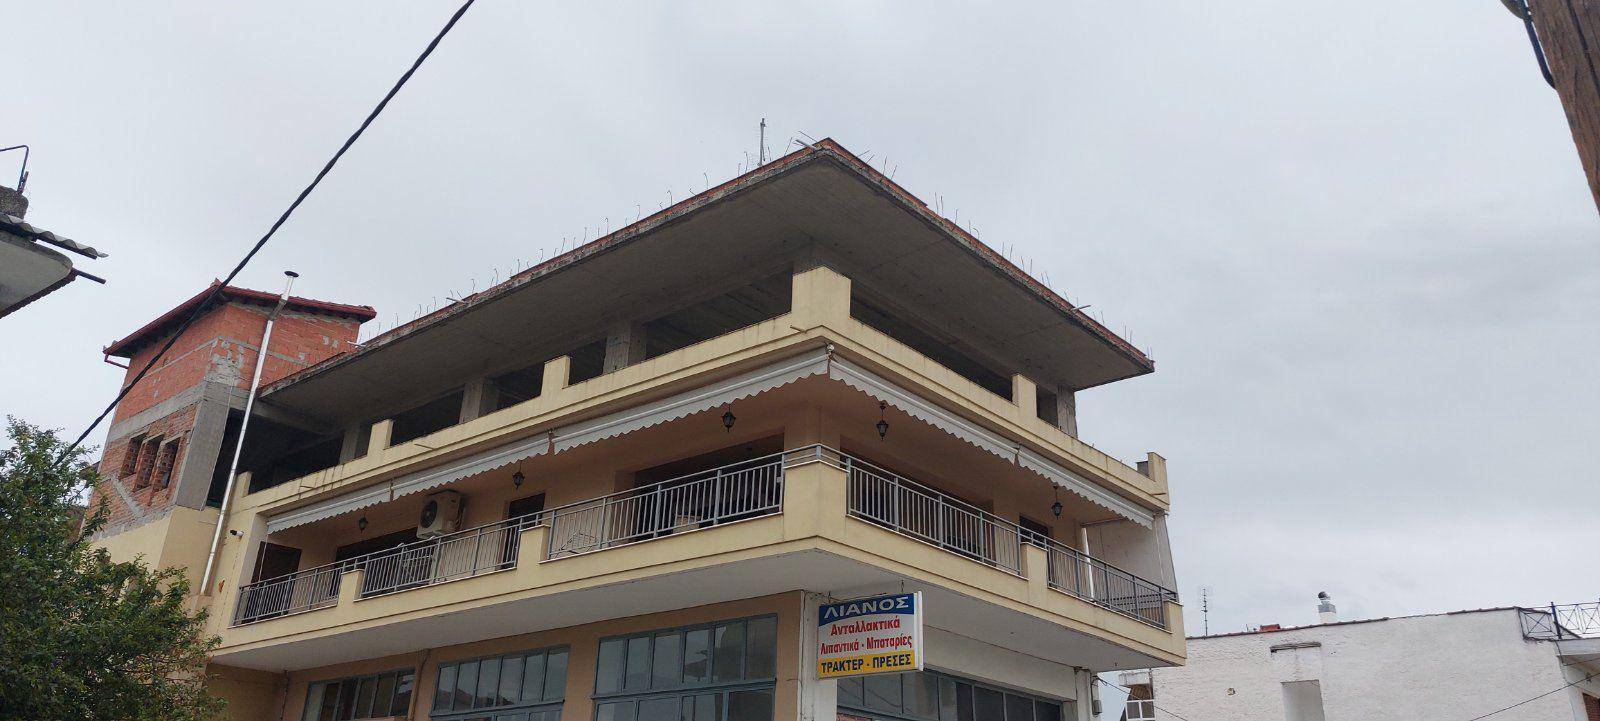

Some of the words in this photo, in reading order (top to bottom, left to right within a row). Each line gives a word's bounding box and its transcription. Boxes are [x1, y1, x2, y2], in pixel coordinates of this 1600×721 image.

[824, 596, 909, 618] ΛΙΑΝΟΣ
[830, 615, 900, 636] Ανταλλακτικά
[820, 639, 859, 655] Λιπαντικά
[866, 633, 912, 650] Μπαταρίες
[821, 659, 864, 674] ΤΡΑΚΤΕΡ
[872, 653, 911, 669] ΠΡΕΣΕΣ
